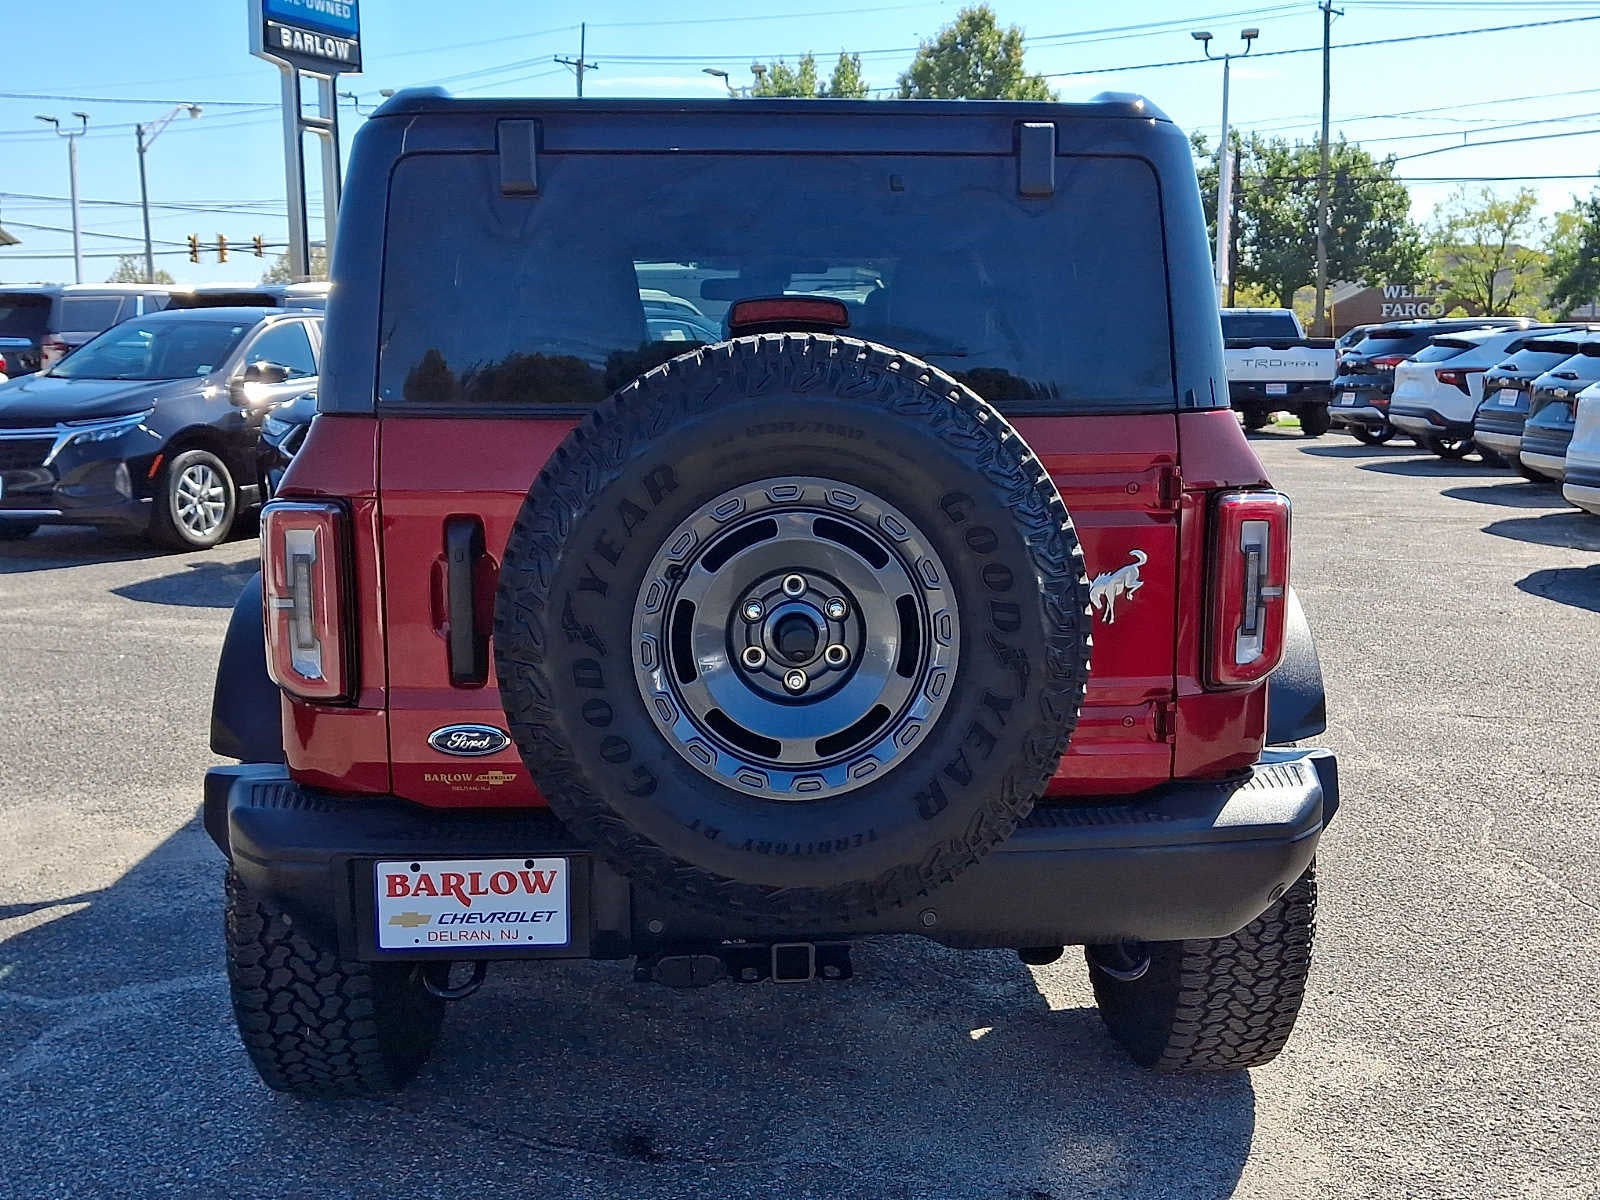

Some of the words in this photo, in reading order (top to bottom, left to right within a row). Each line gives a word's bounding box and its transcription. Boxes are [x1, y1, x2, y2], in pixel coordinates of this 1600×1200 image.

[280, 27, 350, 60] BARLOW
[1381, 302, 1445, 317] FARGO
[447, 732, 491, 749] Ford
[424, 773, 473, 785] BARLOW
[385, 870, 557, 908] BARLOW
[437, 911, 558, 925] CHEVROLET
[427, 930, 495, 942] DELRAN,
[501, 929, 519, 940] NJ
